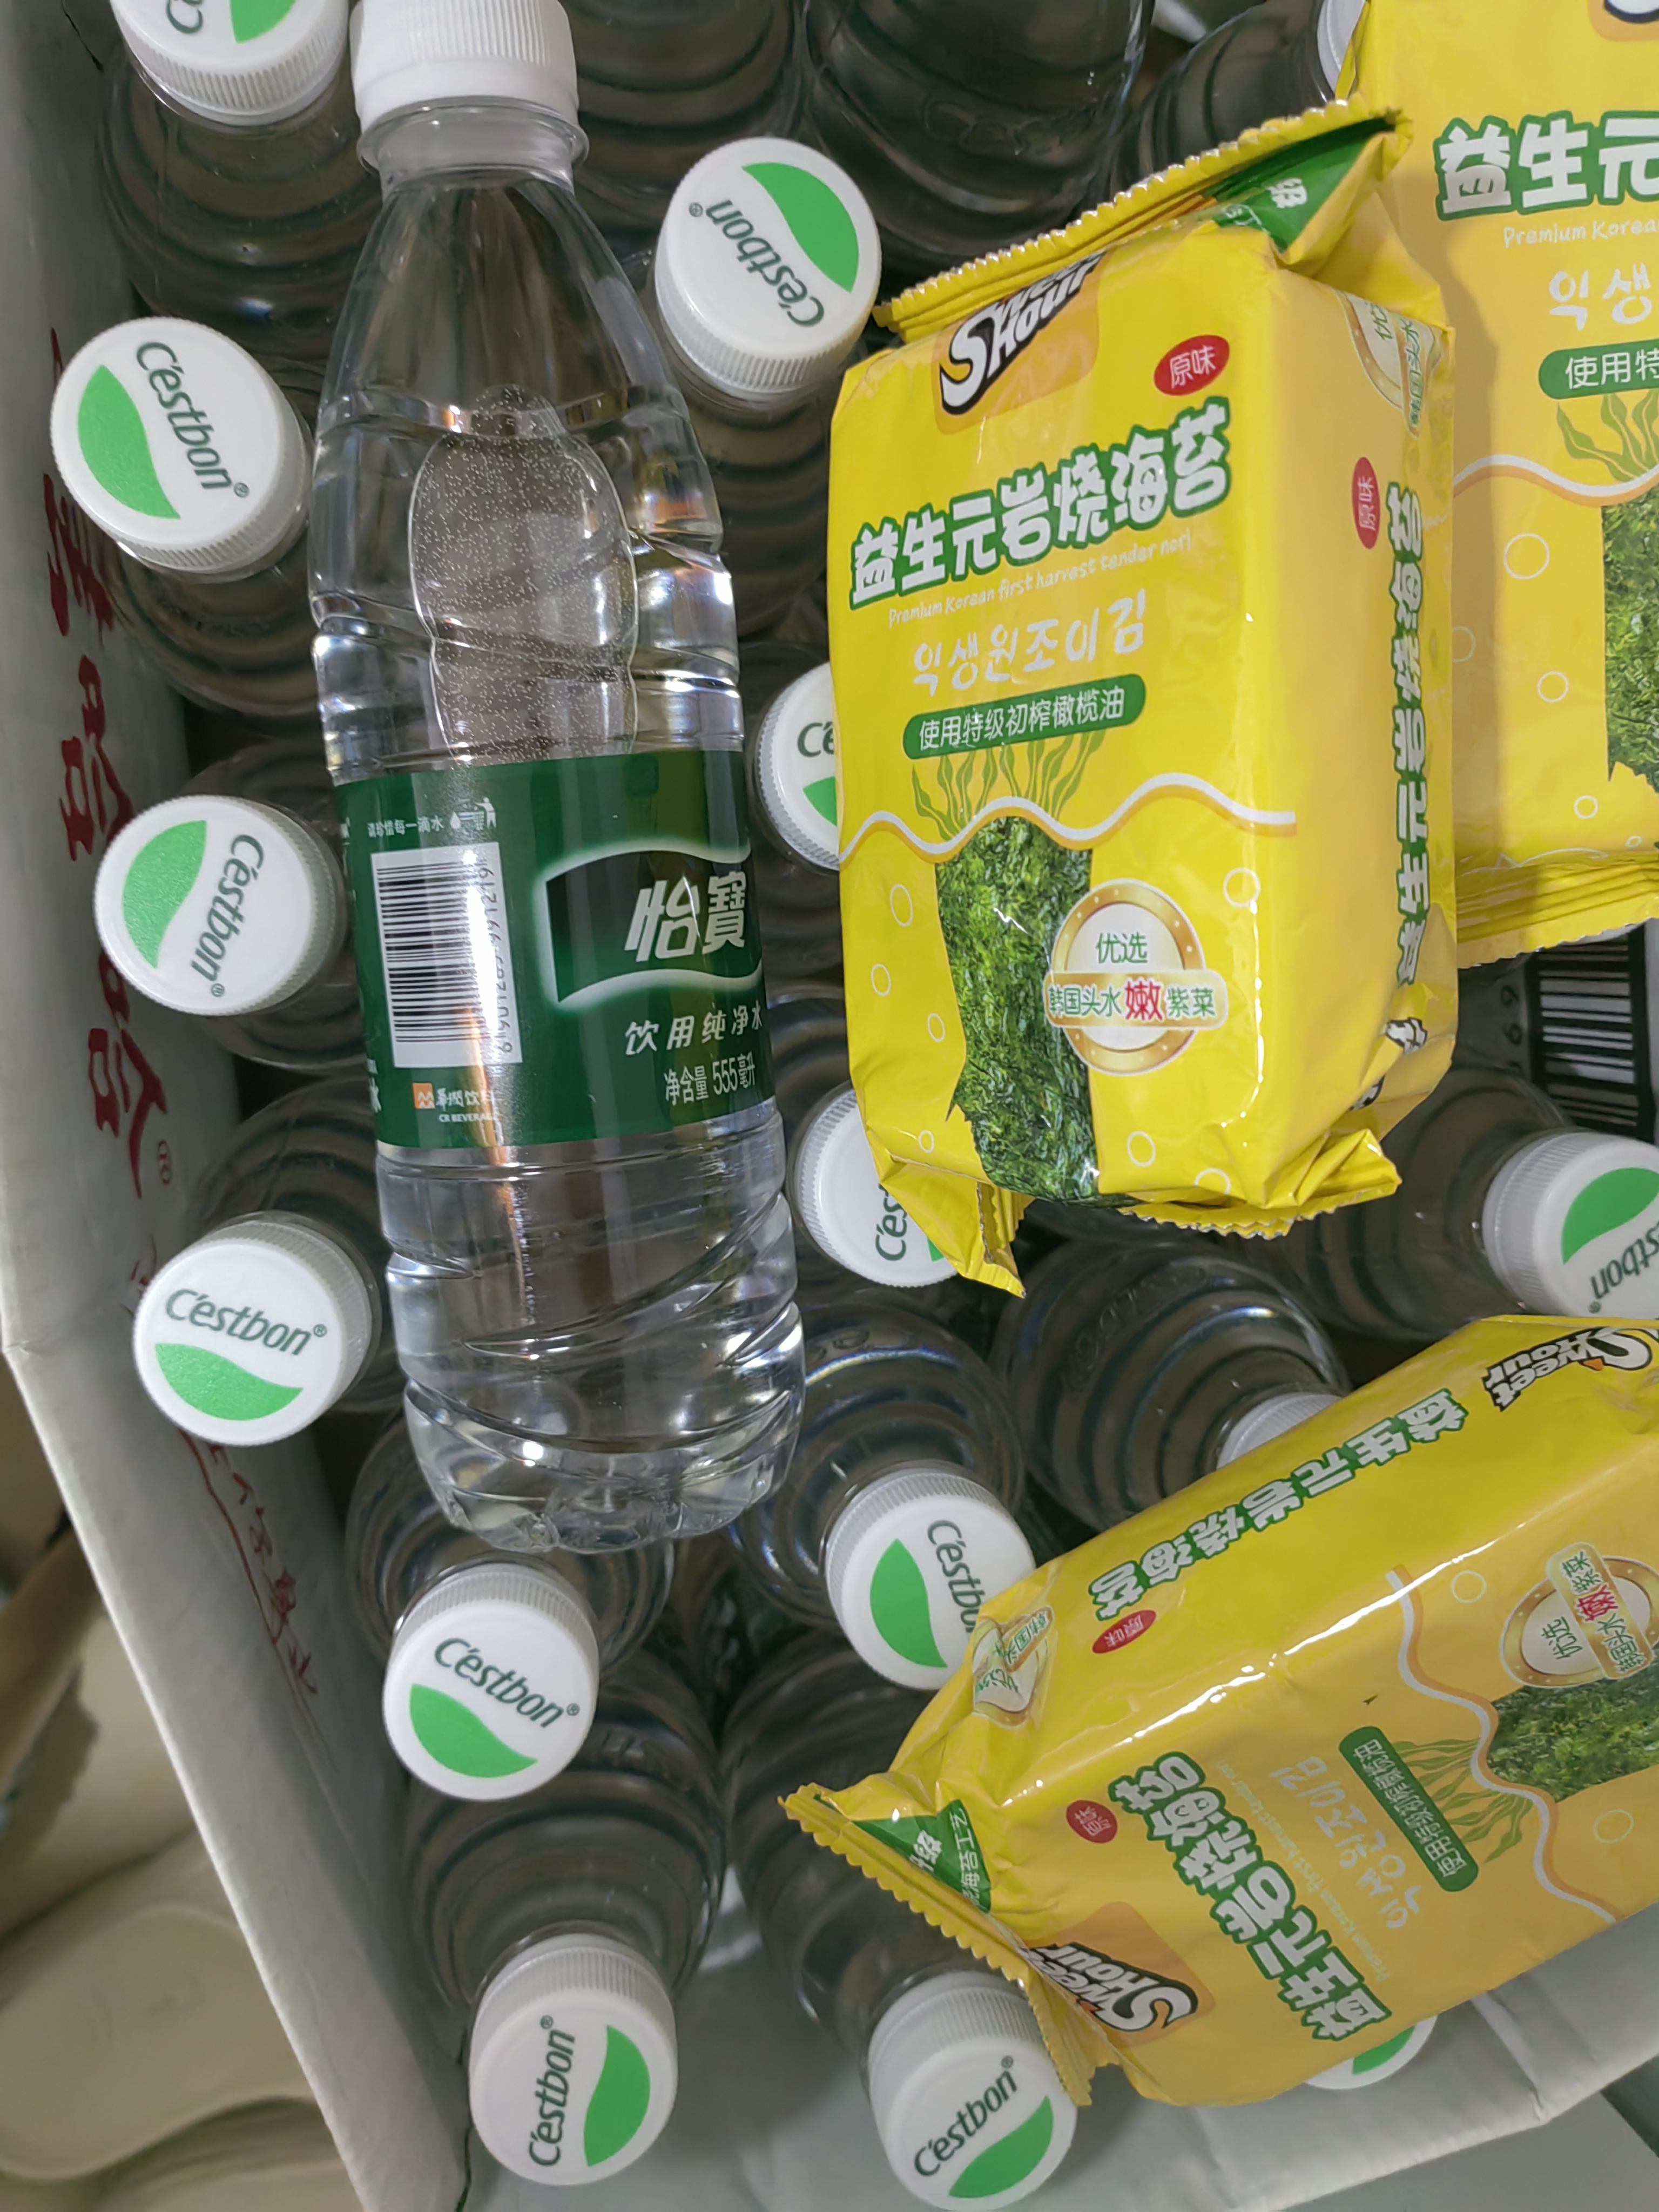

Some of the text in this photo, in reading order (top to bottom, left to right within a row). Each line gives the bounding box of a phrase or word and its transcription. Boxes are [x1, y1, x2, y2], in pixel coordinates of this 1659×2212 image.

[1504, 220, 1659, 248] Premium Korea
[1169, 344, 1219, 389] 原味
[851, 397, 1230, 610] 益生元岩烧海苔
[888, 528, 1192, 628] Premium Korean first harvest tender nori
[919, 685, 1125, 752] 使用特级初榨橄榄油
[1096, 932, 1148, 963] 优选
[624, 1000, 763, 1055] 饮用纯净水
[664, 1064, 710, 1106] 净含量
[1088, 1387, 1469, 1621] 益生元岩烧海苔
[1104, 1615, 1144, 1648] 原味
[1541, 1616, 1583, 1660] 优选
[1109, 1751, 1392, 2041] 益生元岩烧海苔
